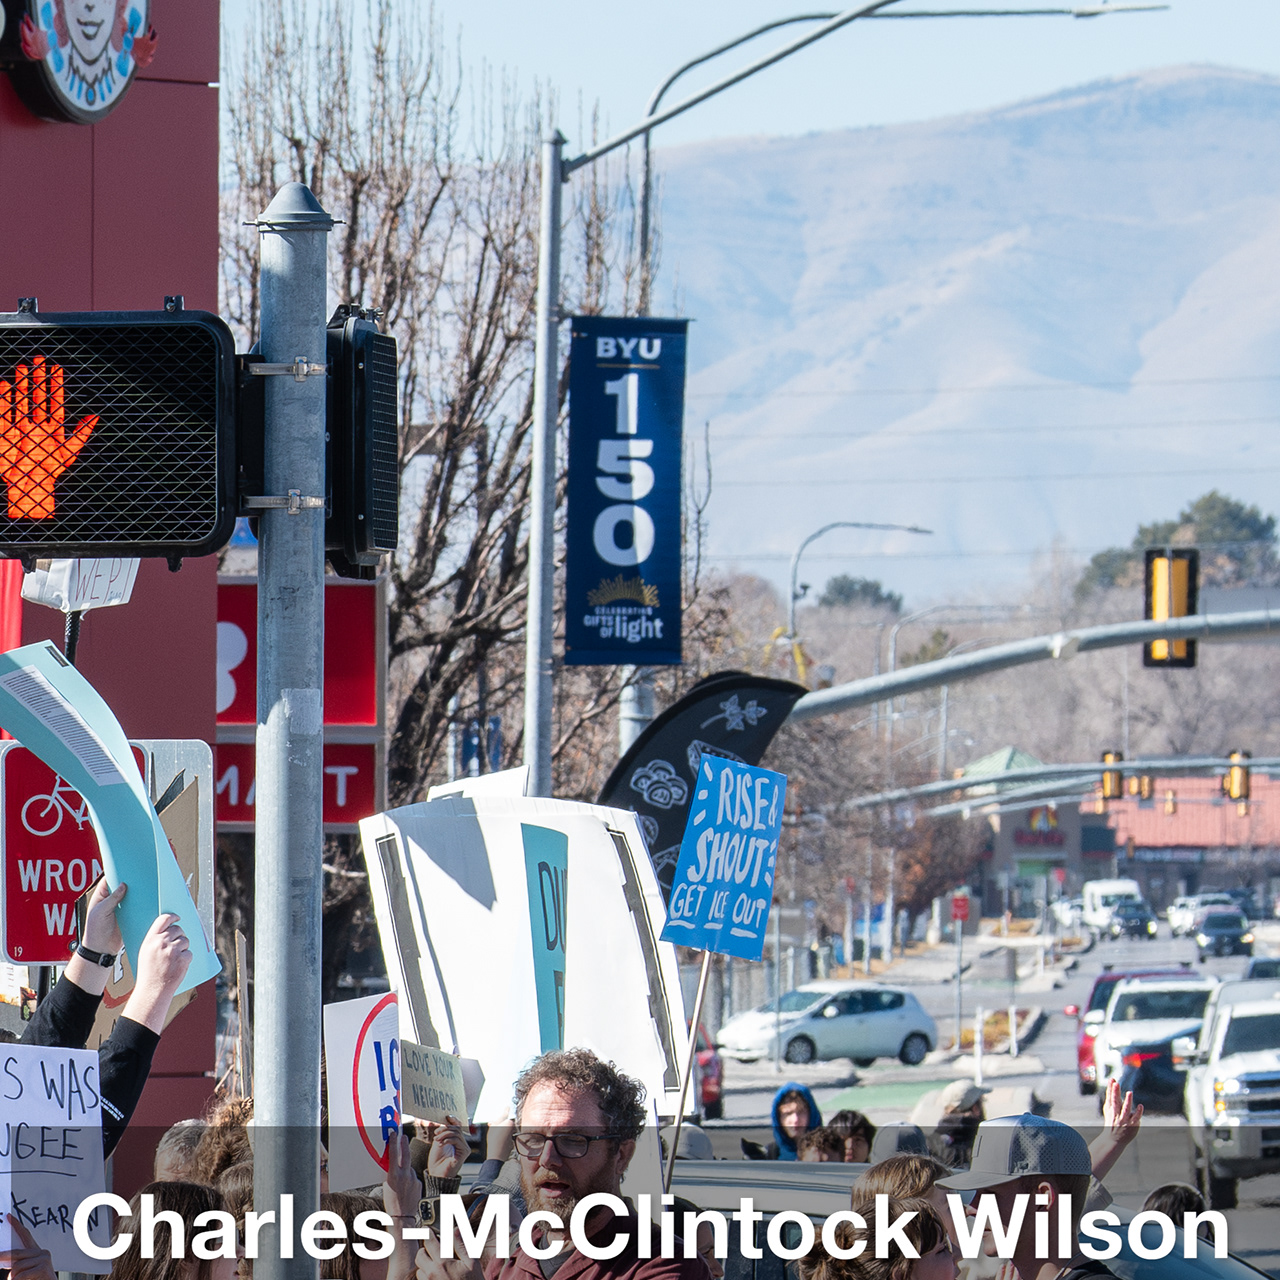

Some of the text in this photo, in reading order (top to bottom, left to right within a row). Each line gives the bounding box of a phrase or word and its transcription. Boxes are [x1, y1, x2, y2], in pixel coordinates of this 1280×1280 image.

[596, 337, 661, 359] BYU
[593, 373, 655, 567] 150
[583, 614, 614, 627] GIFTS
[600, 627, 613, 638] OF
[614, 615, 663, 643] light
[716, 767, 779, 831] RISE &
[687, 826, 770, 888] SHOUT
[18, 858, 104, 892] WRON
[670, 882, 767, 929] GET ICE OUT
[13, 945, 24, 958] 19
[403, 1049, 456, 1081] LOVE YOUR
[40, 1057, 99, 1121] WAS
[411, 1083, 458, 1112] NEIGHBOR
[10, 1191, 100, 1234] KEARN
